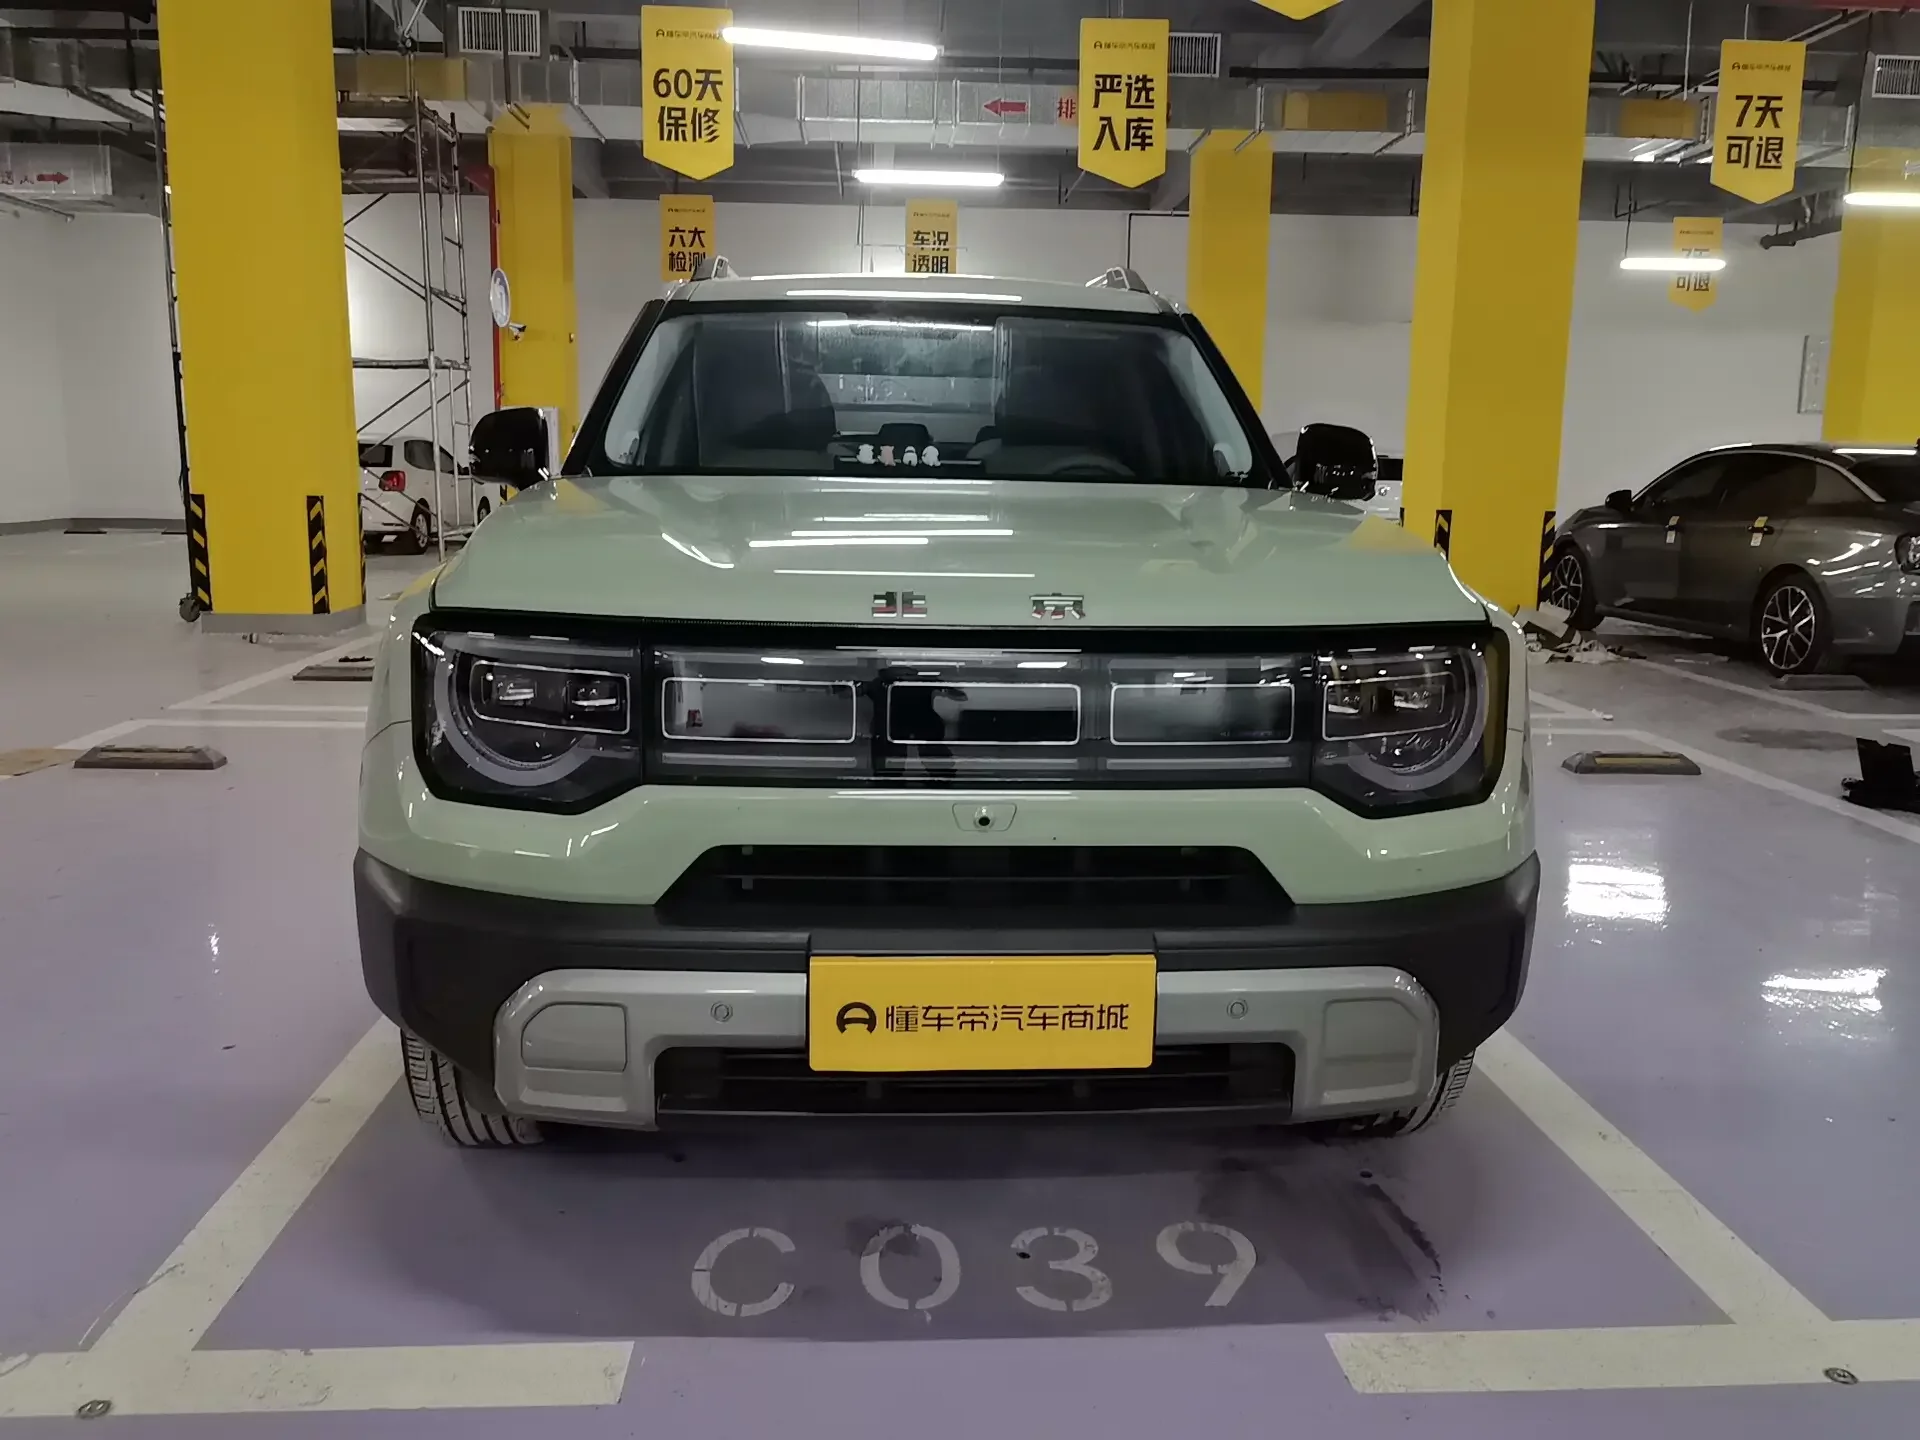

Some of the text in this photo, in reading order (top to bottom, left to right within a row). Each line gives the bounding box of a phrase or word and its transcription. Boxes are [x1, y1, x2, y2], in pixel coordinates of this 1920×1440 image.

[653, 68, 723, 102] 60天
[1092, 74, 1155, 109] 严选
[657, 106, 720, 143] 保修
[1735, 95, 1783, 129] 7天
[1092, 116, 1154, 151] 入库
[1726, 136, 1784, 170] 可退
[668, 226, 706, 248] 六大
[912, 230, 950, 251] 车况
[912, 254, 949, 274] 透明
[885, 1003, 1129, 1033] 懂车帝汽车商城
